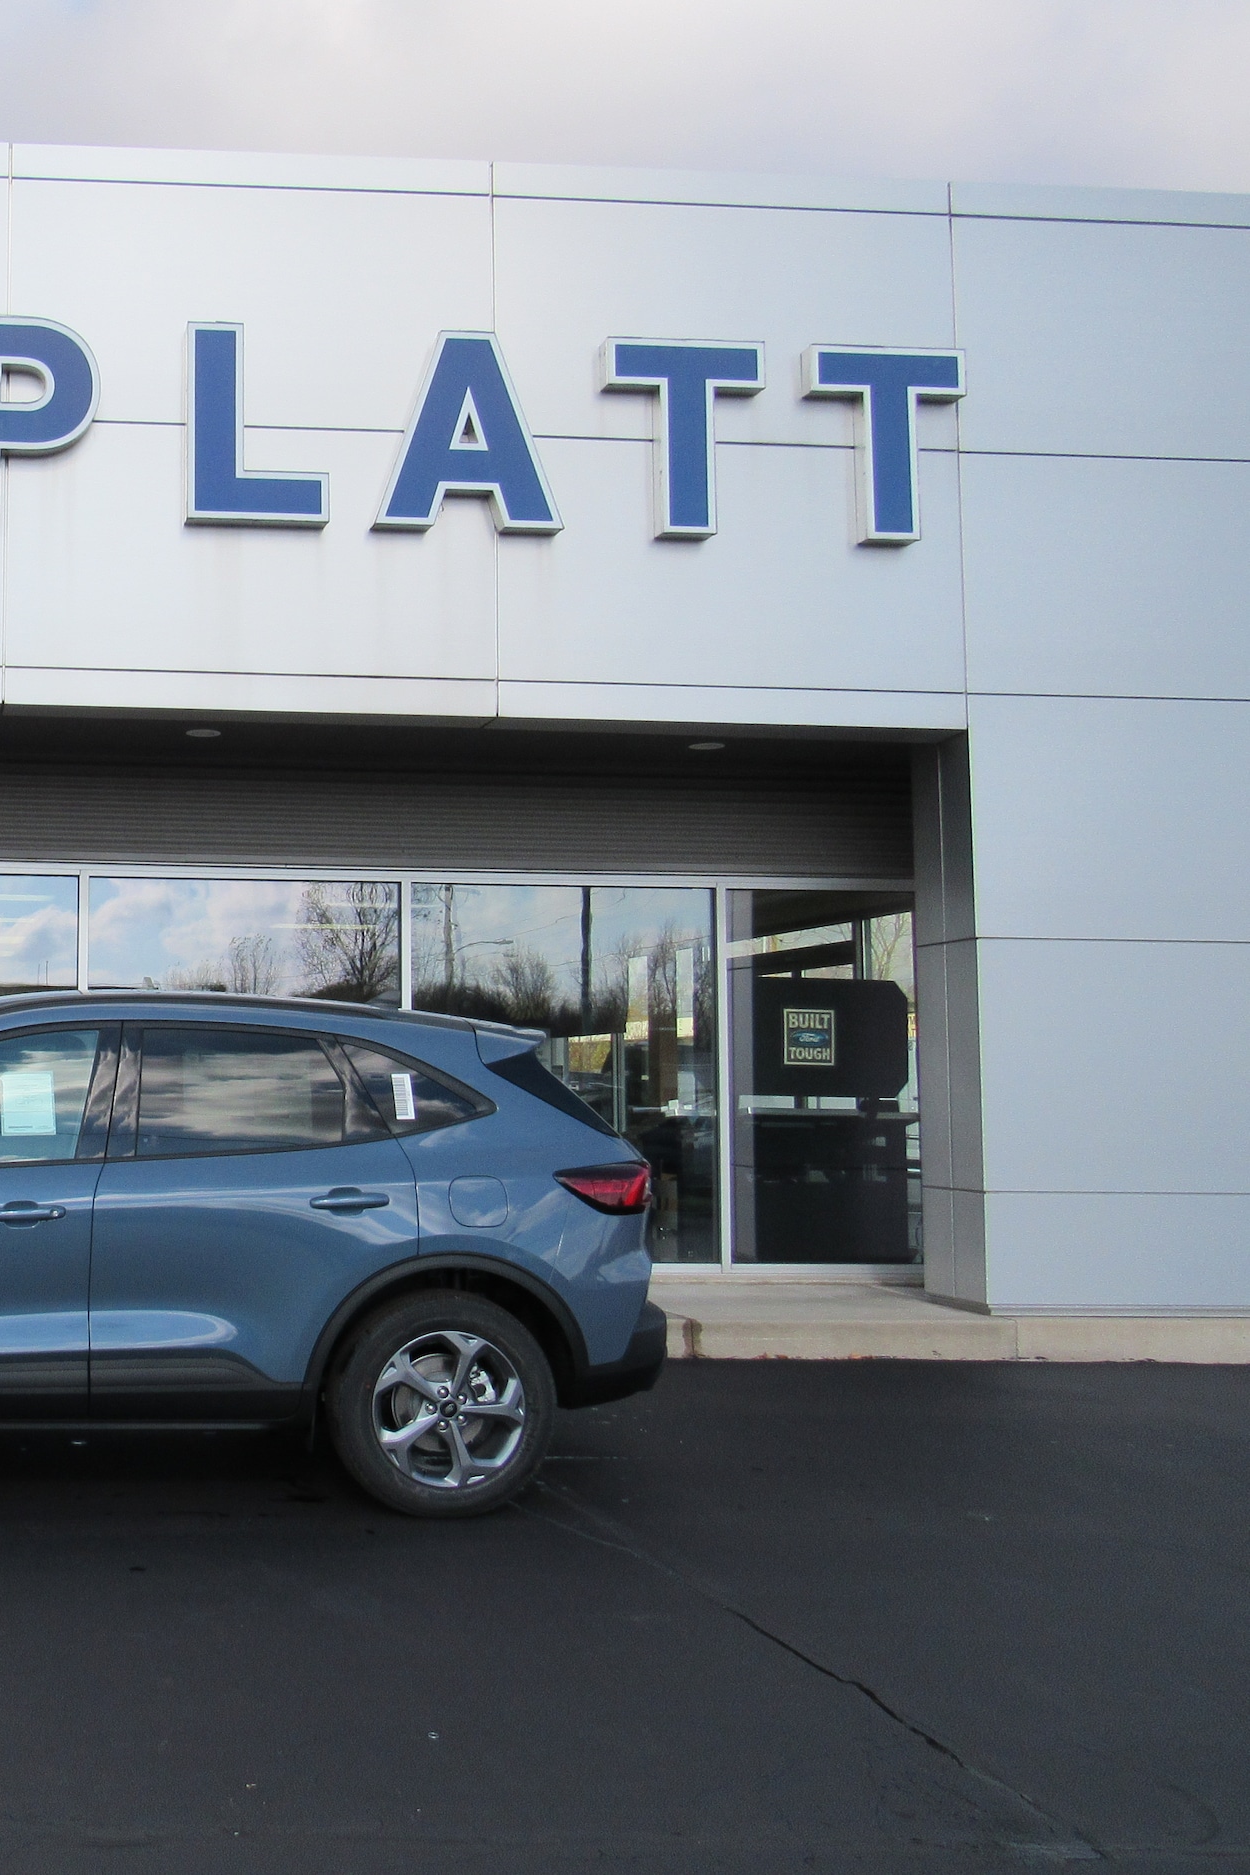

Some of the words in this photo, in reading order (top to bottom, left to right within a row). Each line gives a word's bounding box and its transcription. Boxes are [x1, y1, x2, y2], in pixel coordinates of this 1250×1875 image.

[788, 1012, 830, 1029] BUILT
[799, 1032, 820, 1042] Ford
[788, 1047, 830, 1060] TOUGH
